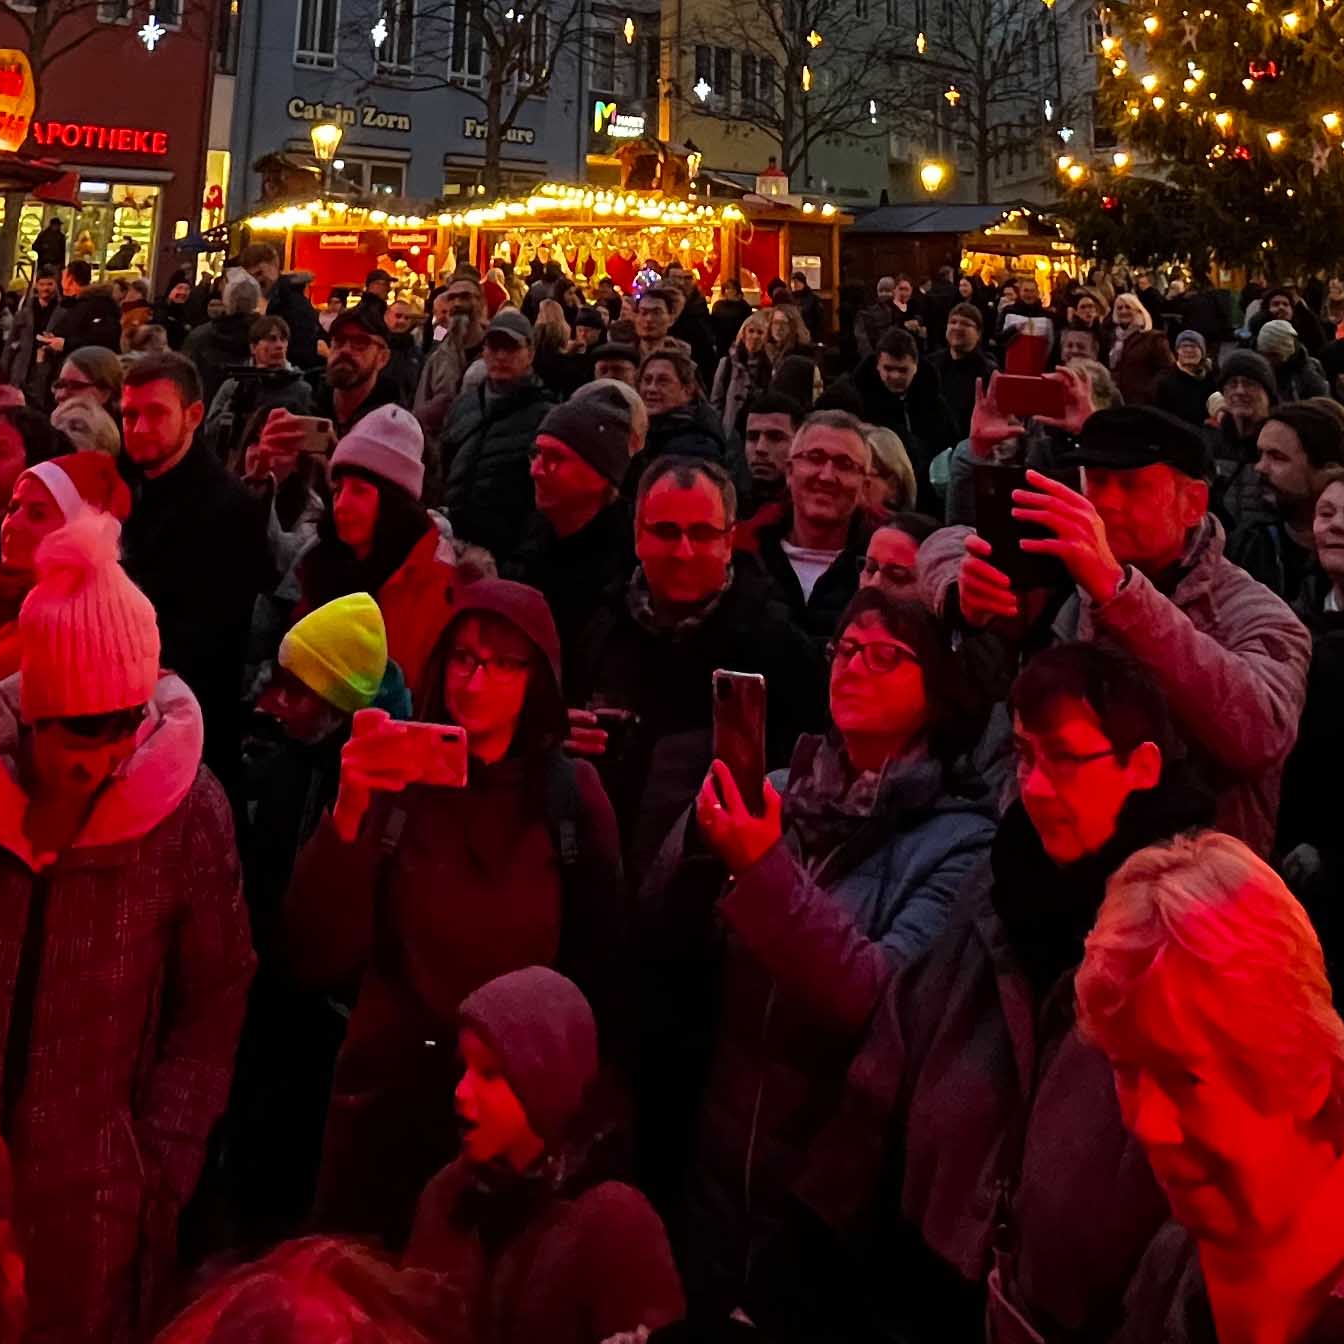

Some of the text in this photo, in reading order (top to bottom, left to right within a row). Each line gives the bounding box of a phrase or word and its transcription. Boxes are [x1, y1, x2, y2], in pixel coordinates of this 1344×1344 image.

[362, 106, 410, 131] Zorn
[464, 118, 534, 144] Friure
[33, 121, 168, 154] APOTHEKE
